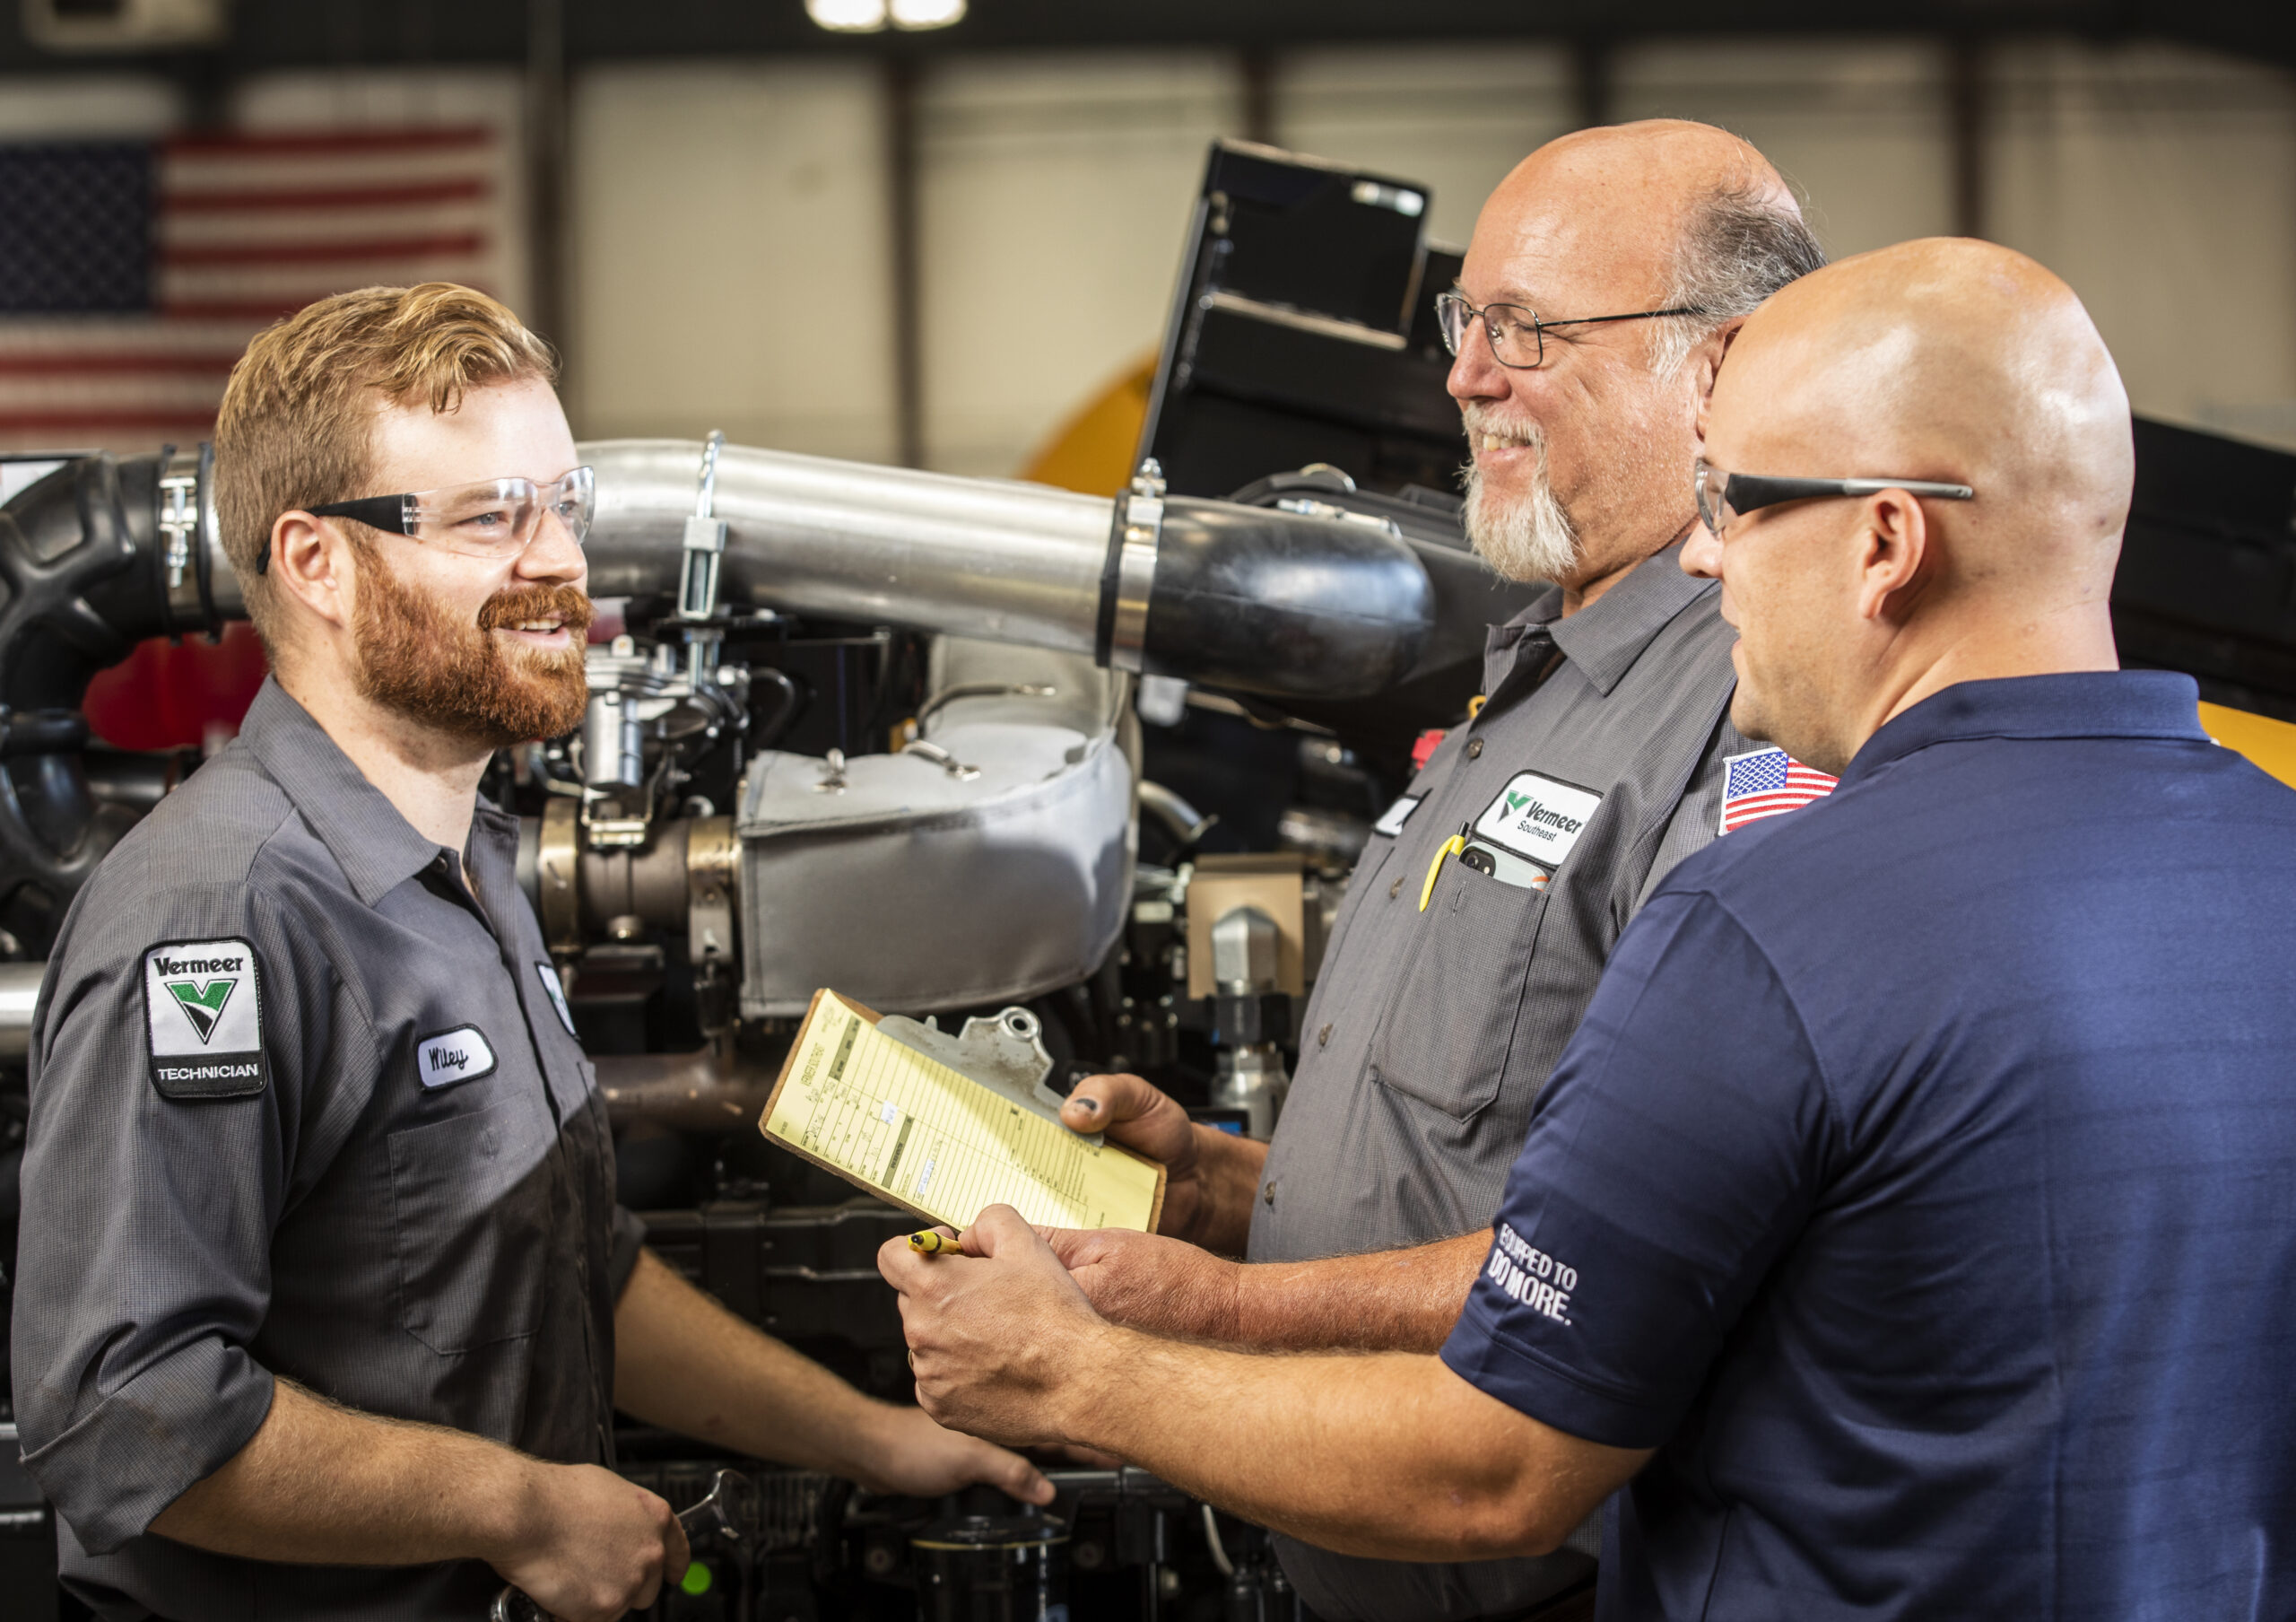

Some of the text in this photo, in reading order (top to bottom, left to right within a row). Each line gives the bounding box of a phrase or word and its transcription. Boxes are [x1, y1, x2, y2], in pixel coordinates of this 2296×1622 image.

[1526, 801, 1582, 834] Vermeer
[1518, 820, 1557, 842] Southeast
[153, 956, 244, 976] Vermeer
[429, 1047, 468, 1070] Wiley
[158, 1064, 258, 1081] TECHNICIAN
[1487, 1248, 1571, 1326] DO MORE.
[1553, 1261, 1578, 1291] TO
